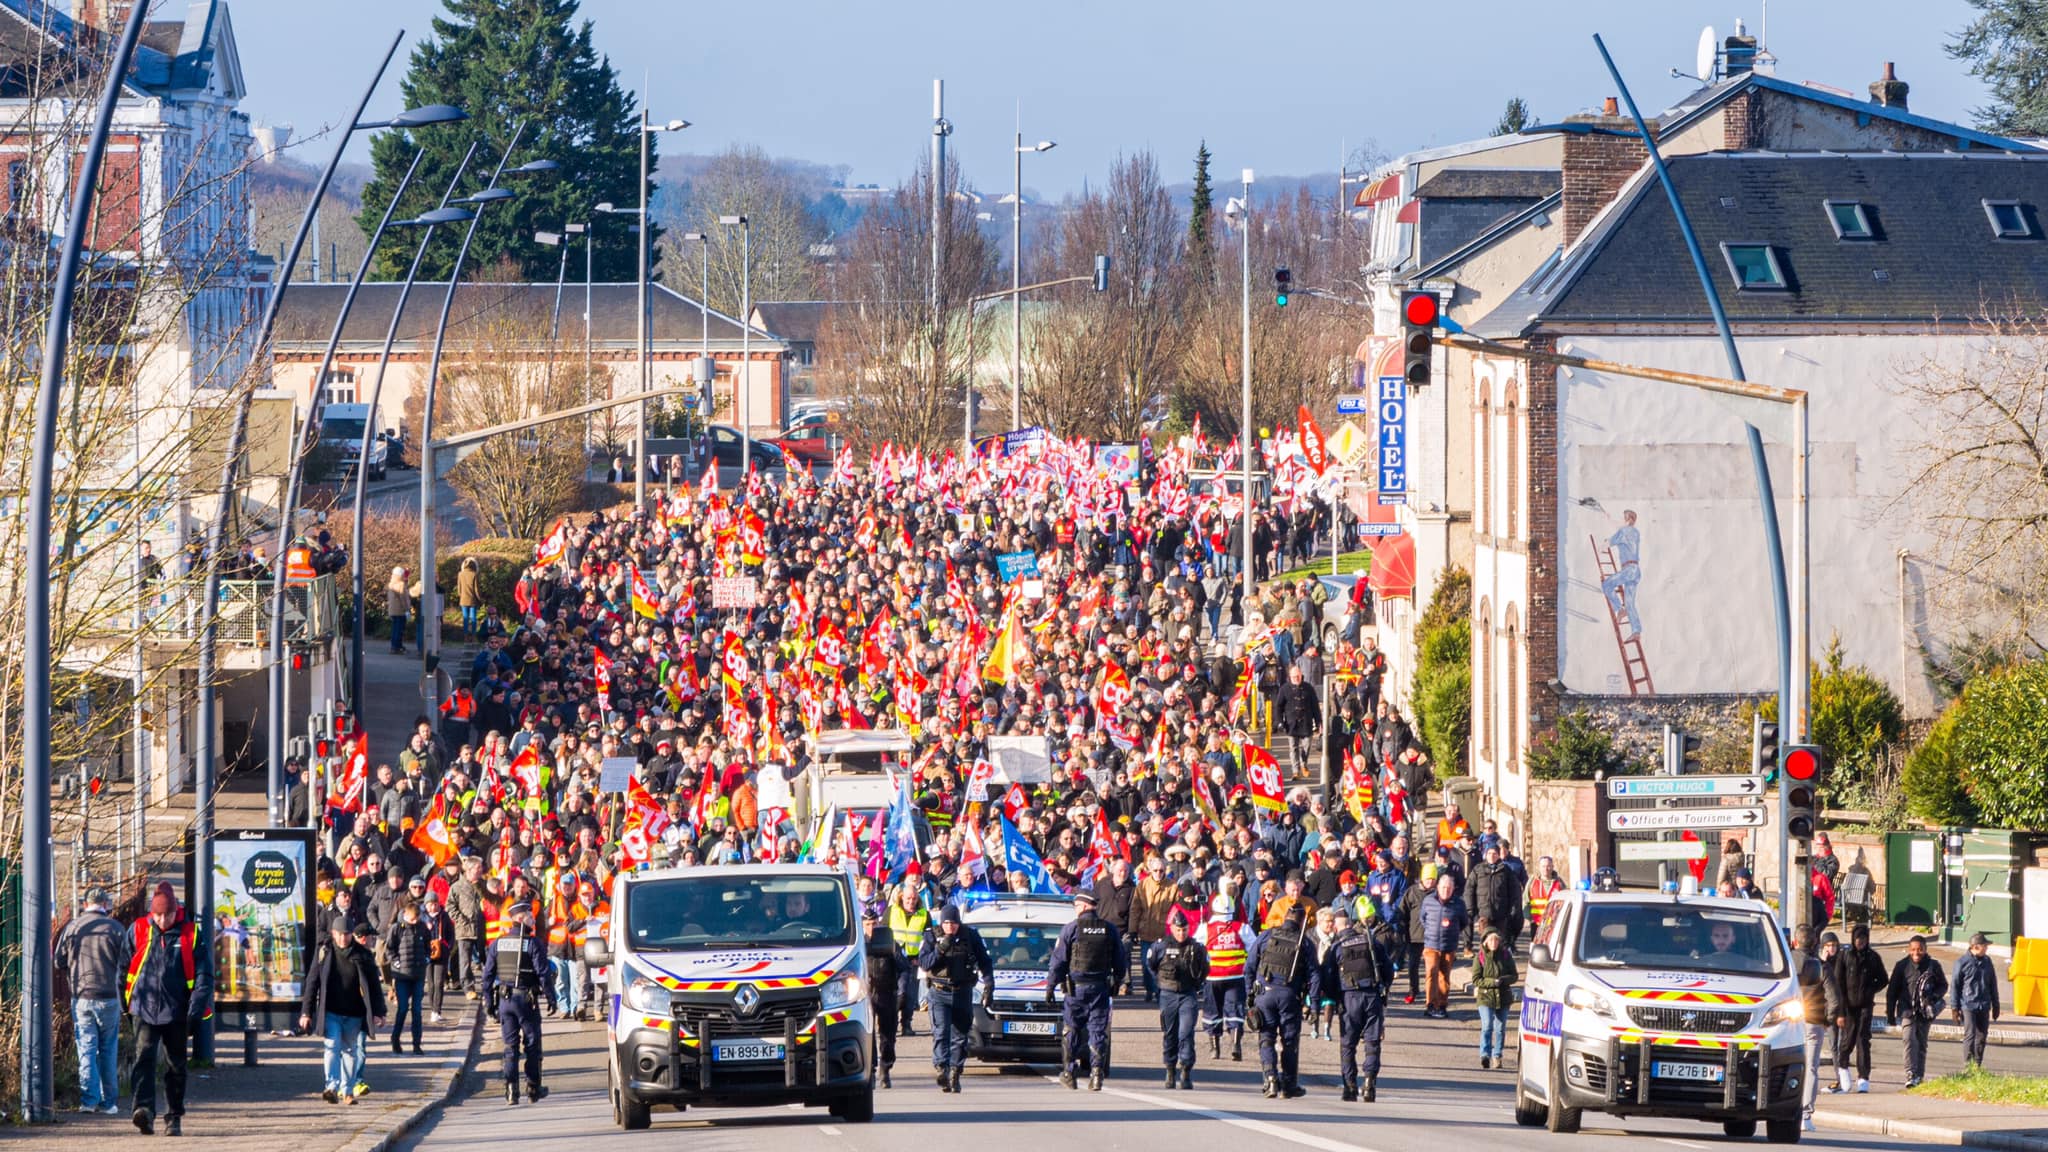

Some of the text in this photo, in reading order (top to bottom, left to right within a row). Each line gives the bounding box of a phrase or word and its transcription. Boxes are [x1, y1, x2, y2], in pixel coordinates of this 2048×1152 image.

[1381, 379, 1405, 490] HOTEL
[1303, 421, 1322, 464] TABAC
[1250, 763, 1282, 797] cgt
[1636, 783, 1673, 793] VICTOR
[1676, 782, 1707, 792] HUGO
[1632, 813, 1733, 825] Office de Tourisme
[255, 877, 265, 886] de
[693, 957, 794, 965] NATIONALE
